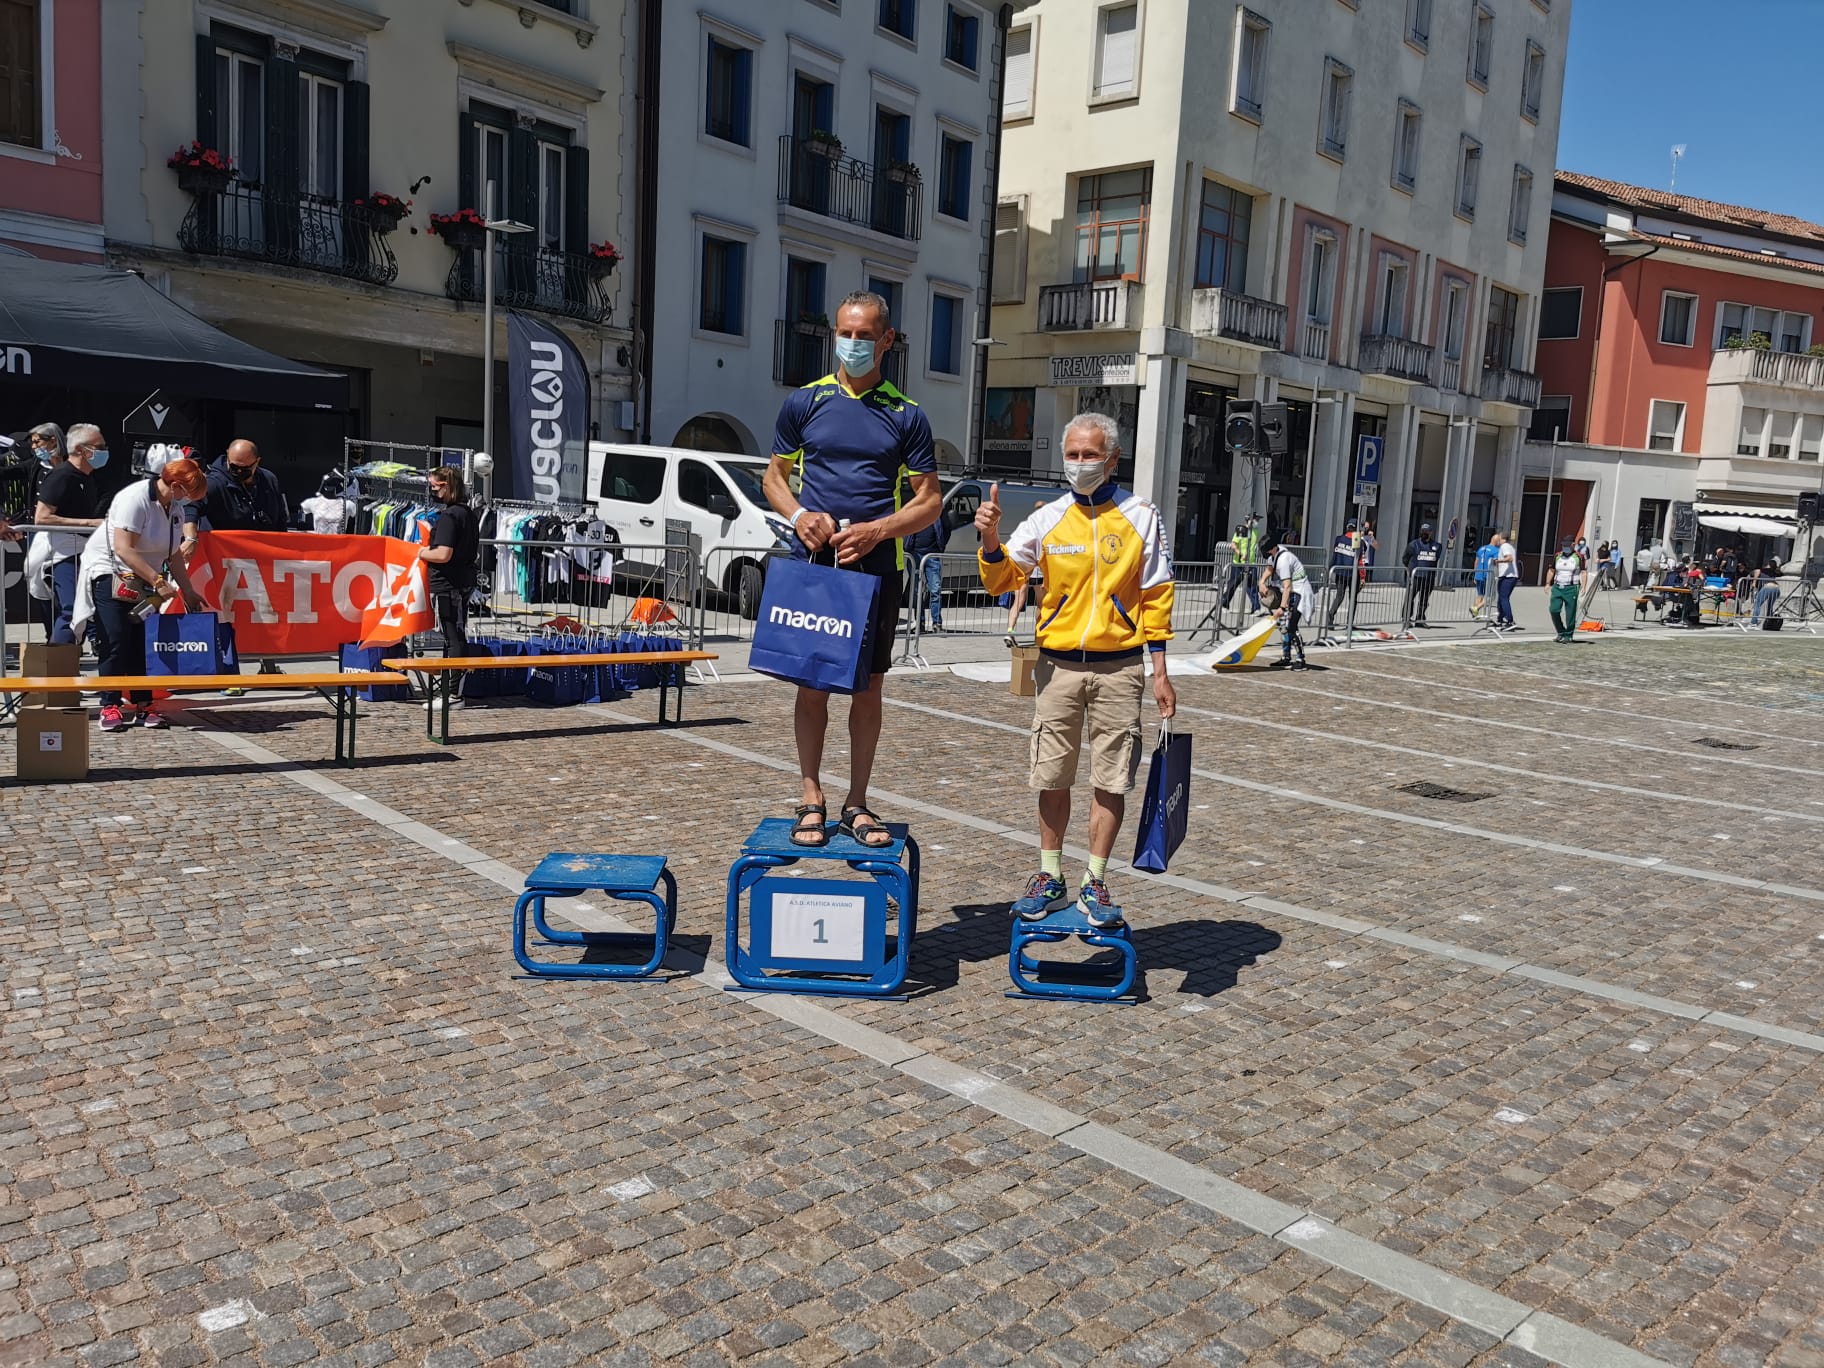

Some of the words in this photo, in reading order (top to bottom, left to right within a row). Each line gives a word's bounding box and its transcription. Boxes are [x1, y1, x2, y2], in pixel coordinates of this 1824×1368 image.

[1052, 355, 1131, 377] TREVISAN
[1361, 441, 1377, 477] P
[769, 605, 853, 639] macron
[153, 640, 208, 652] macron
[812, 918, 829, 944] 1
